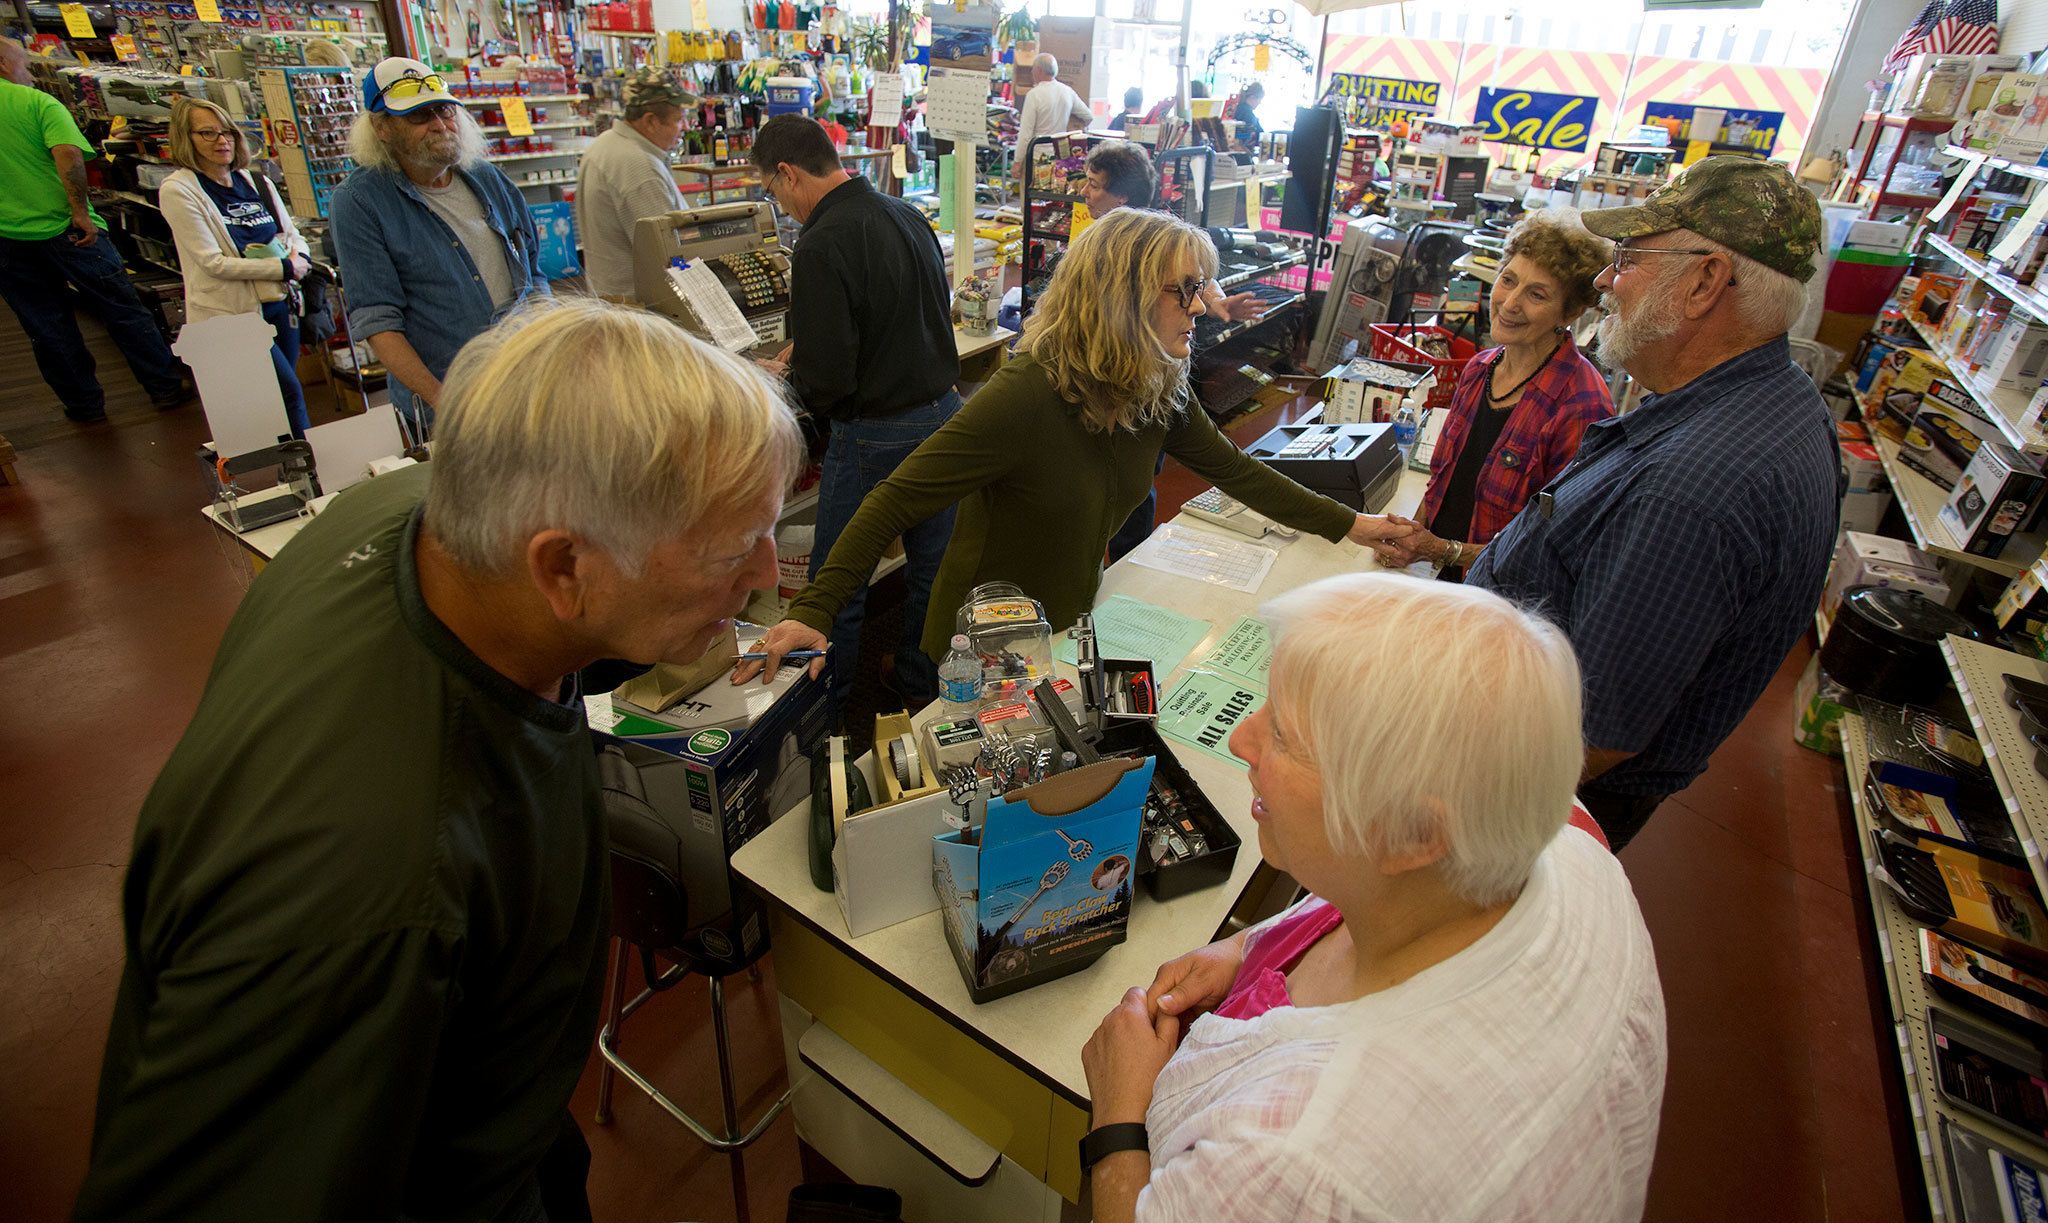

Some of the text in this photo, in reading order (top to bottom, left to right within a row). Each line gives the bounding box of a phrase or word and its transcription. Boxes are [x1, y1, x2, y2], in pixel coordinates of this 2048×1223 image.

[1480, 90, 1588, 148] Sale
[1240, 637, 1266, 662] PAYMENT
[1169, 687, 1197, 712] Quitting
[1178, 690, 1208, 718] Business
[1195, 700, 1213, 716] Sale
[1196, 690, 1255, 749] ALL SALES
[1023, 922, 1057, 941] Back
[1059, 900, 1123, 929] Scratcher
[1042, 893, 1109, 923] Bear Claw
